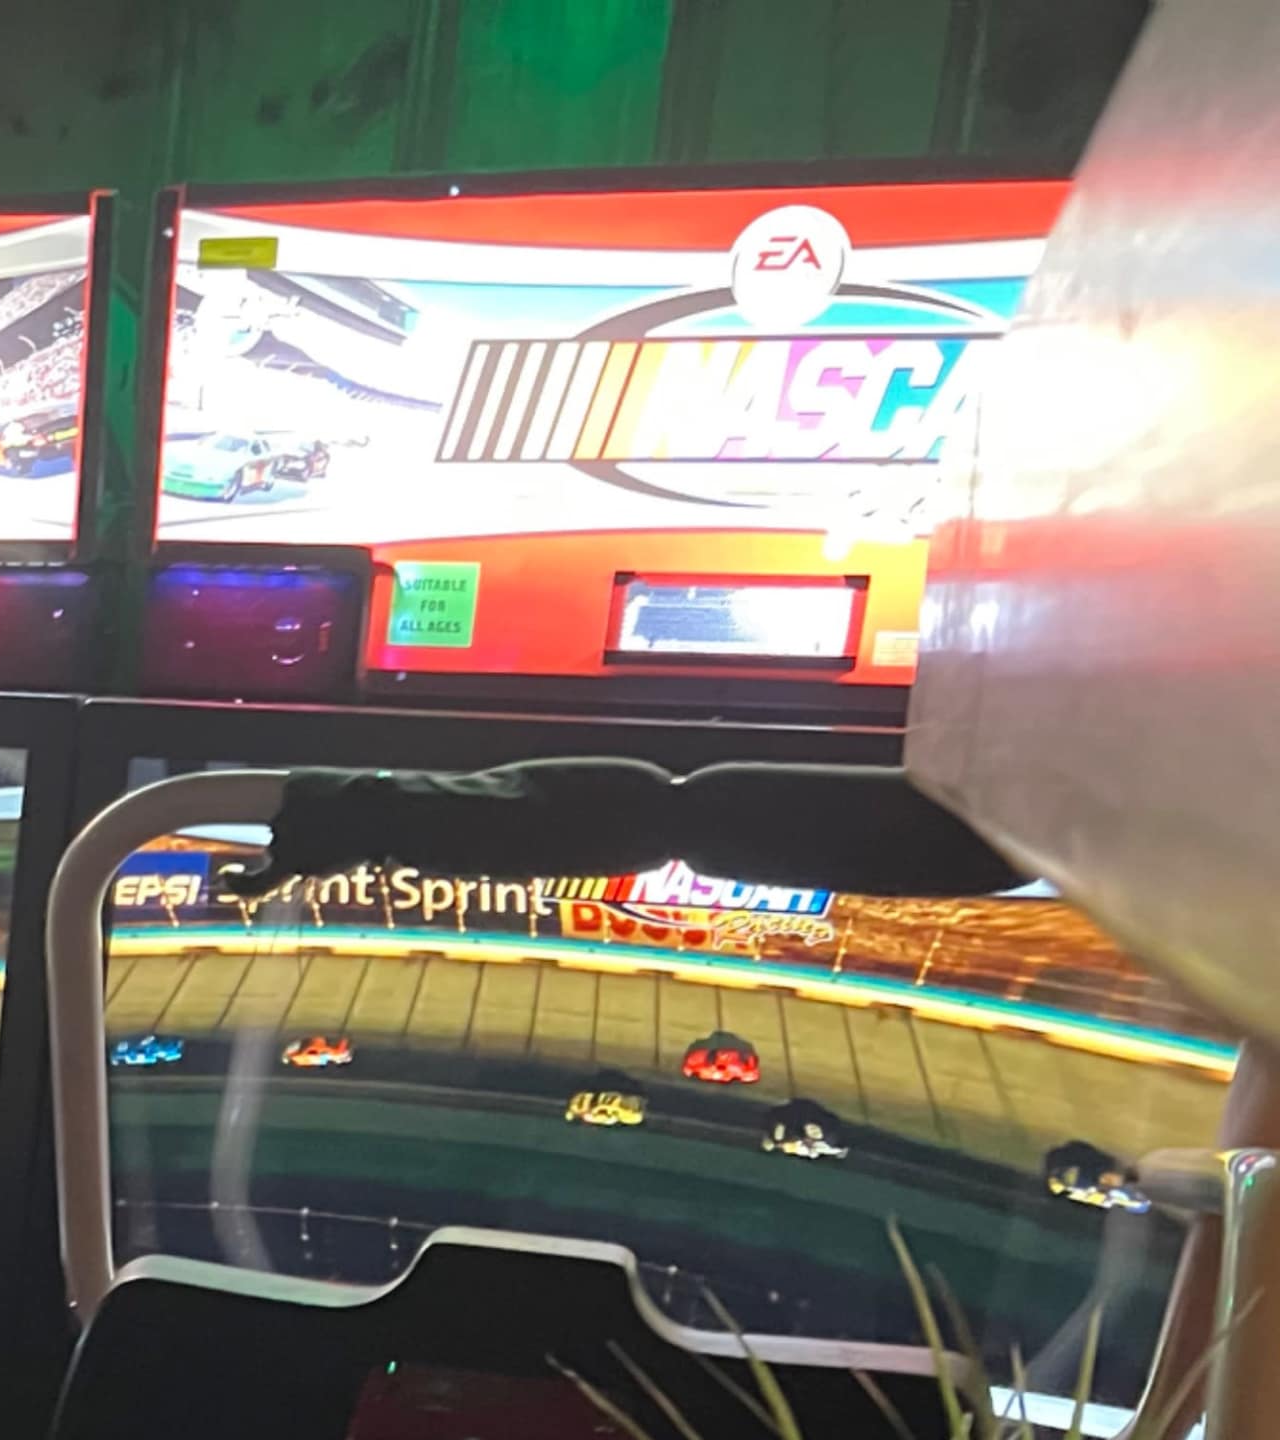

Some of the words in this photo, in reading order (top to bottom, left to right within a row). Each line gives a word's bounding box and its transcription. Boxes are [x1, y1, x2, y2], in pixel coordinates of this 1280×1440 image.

[753, 236, 823, 272] EA
[632, 340, 970, 462] NASCA
[113, 873, 204, 907] EPSI
[390, 868, 552, 922] Sprint
